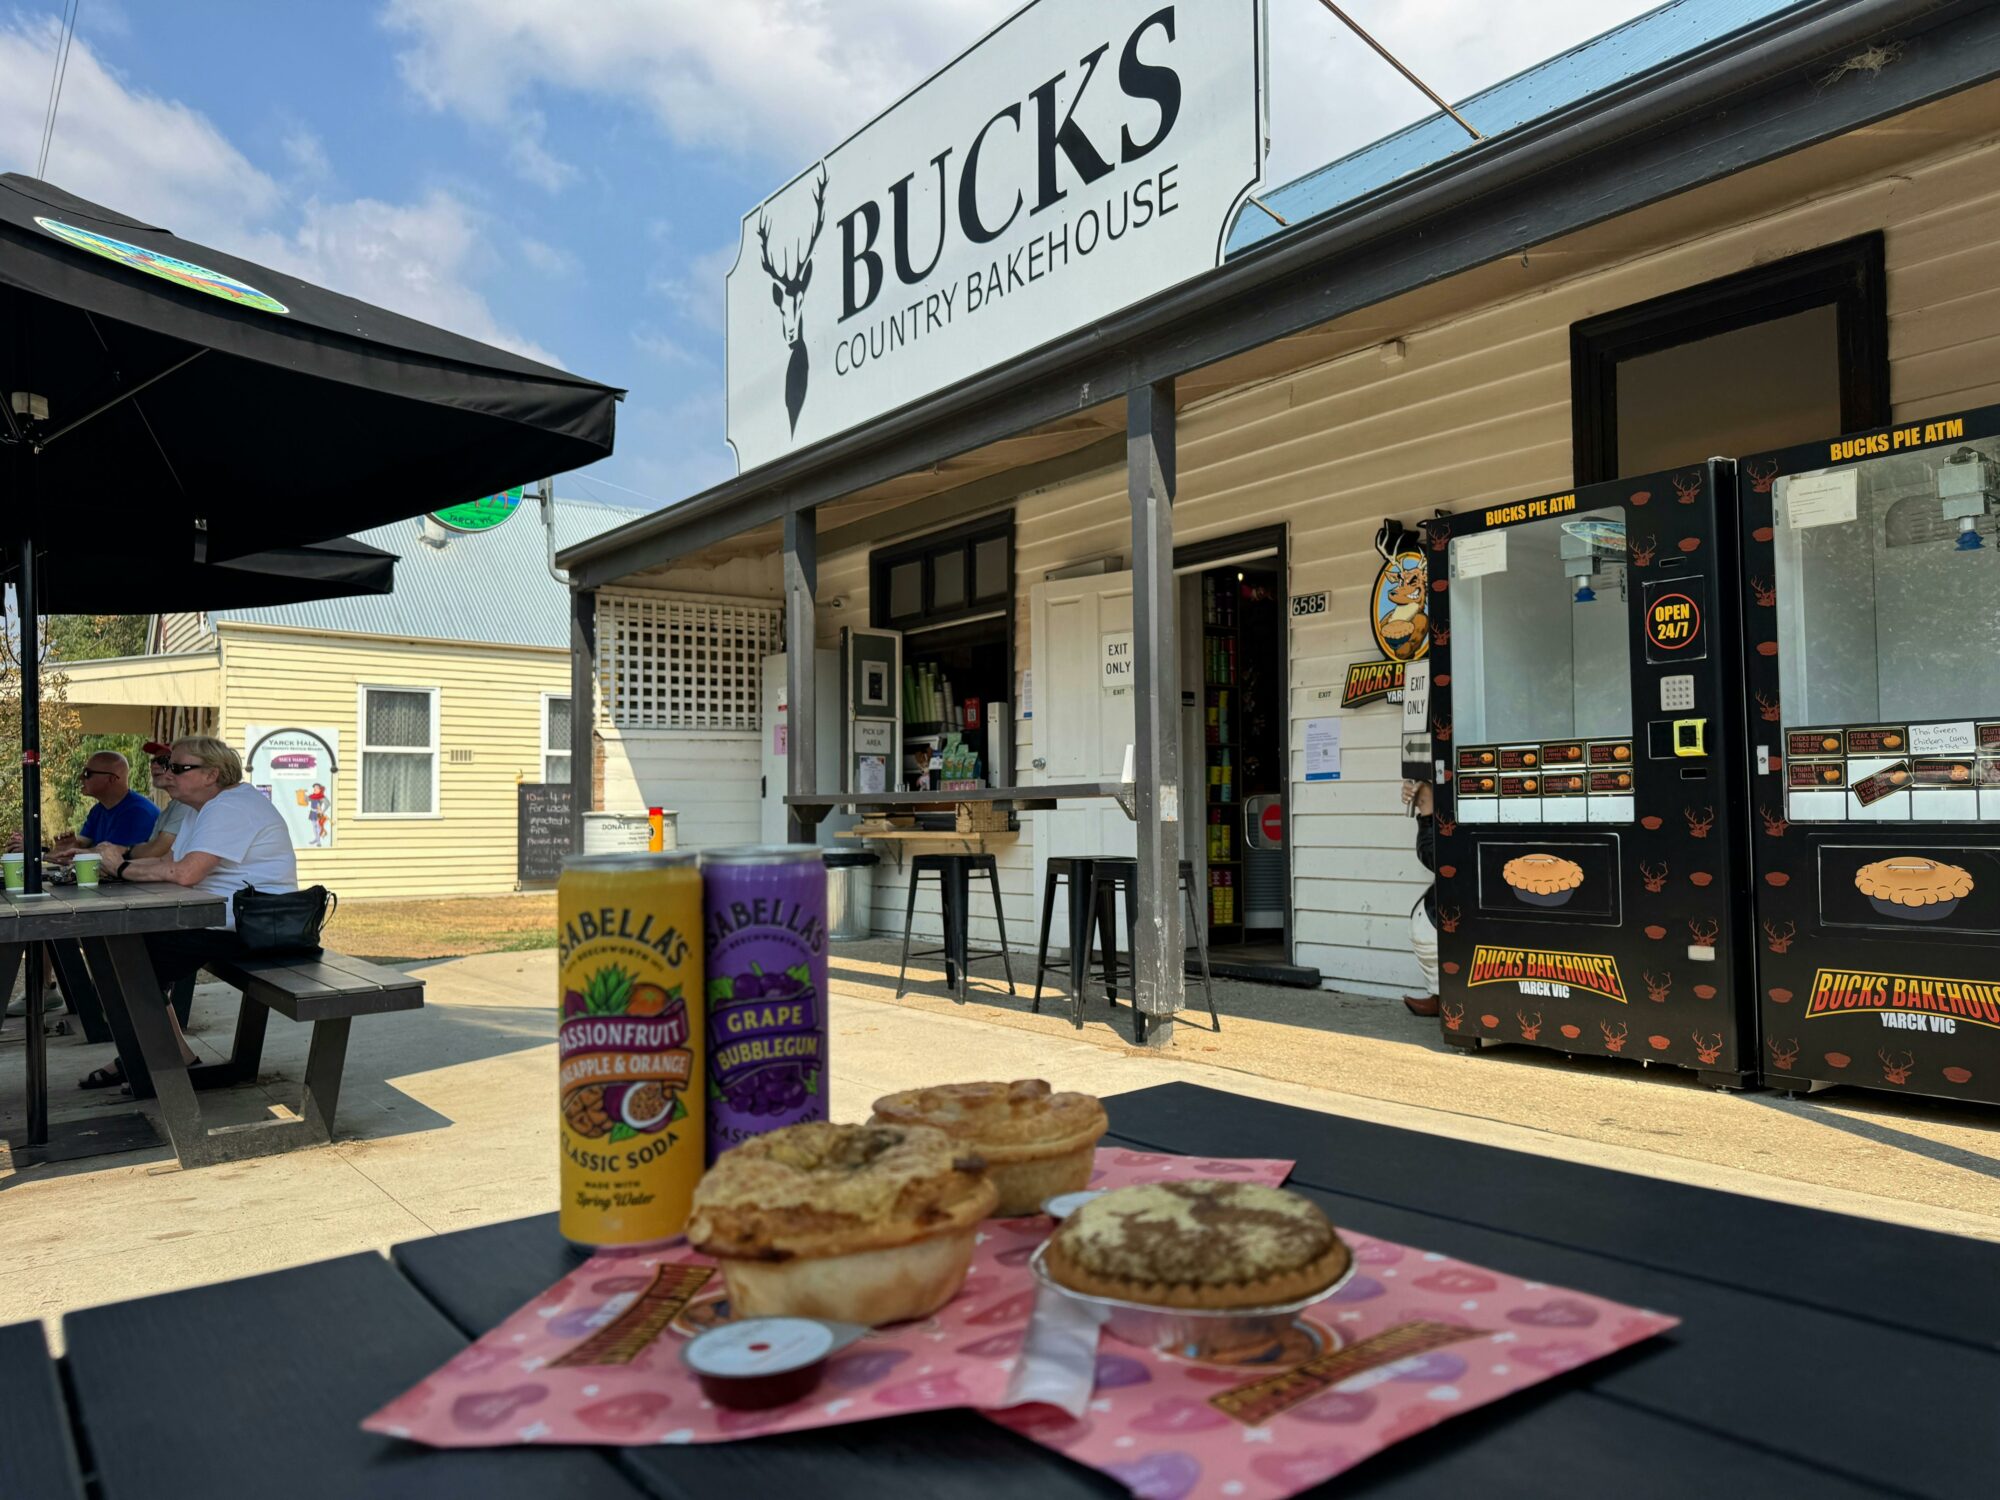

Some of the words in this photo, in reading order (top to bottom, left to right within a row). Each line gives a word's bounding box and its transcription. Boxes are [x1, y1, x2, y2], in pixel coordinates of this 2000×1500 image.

[836, 5, 1182, 324] BUCKS
[834, 282, 959, 376] COUNTRY
[966, 163, 1179, 314] BAKEHOUSE
[1830, 433, 1889, 461] BUCKS
[1893, 427, 1921, 449] PIE
[1925, 418, 1964, 443] ATM
[1485, 504, 1526, 526] BUCKS
[1528, 500, 1547, 518] PIE
[1549, 494, 1575, 514] ATM
[1292, 594, 1326, 616] 6585
[1655, 603, 1690, 622] OPEN
[1657, 622, 1688, 640] 24/7
[1108, 643, 1128, 656] EXIT
[1105, 661, 1131, 675] ONLY
[1113, 688, 1125, 696] EXIT
[1347, 664, 1392, 700] BUCKS
[1411, 675, 1425, 691] EXIT
[1318, 690, 1332, 699] EXIT
[1407, 699, 1425, 715] ONLY
[862, 727, 875, 736] PICK
[876, 728, 885, 736] UP
[1912, 727, 1931, 735] Thai
[1933, 726, 1957, 735] Green
[866, 739, 882, 747] AREA
[1472, 948, 1524, 981] BUCKS
[1527, 952, 1621, 997] BAKEHOUSE
[1518, 981, 1551, 996] YARCK
[1552, 982, 1570, 999] VIC
[1813, 973, 1889, 1013] BUCKS
[727, 1005, 803, 1033] GRAPE
[1880, 1012, 1928, 1032] YARCK
[1928, 1015, 1956, 1035] VIC
[717, 1036, 818, 1071] BUBBLEGUM
[614, 1055, 626, 1074] &
[629, 1054, 686, 1074] ORANGE
[626, 1130, 679, 1169] SODA
[585, 1181, 610, 1189] MADE
[613, 1181, 641, 1189] WITH
[576, 1191, 612, 1212] Spring
[613, 1193, 656, 1207] Water
